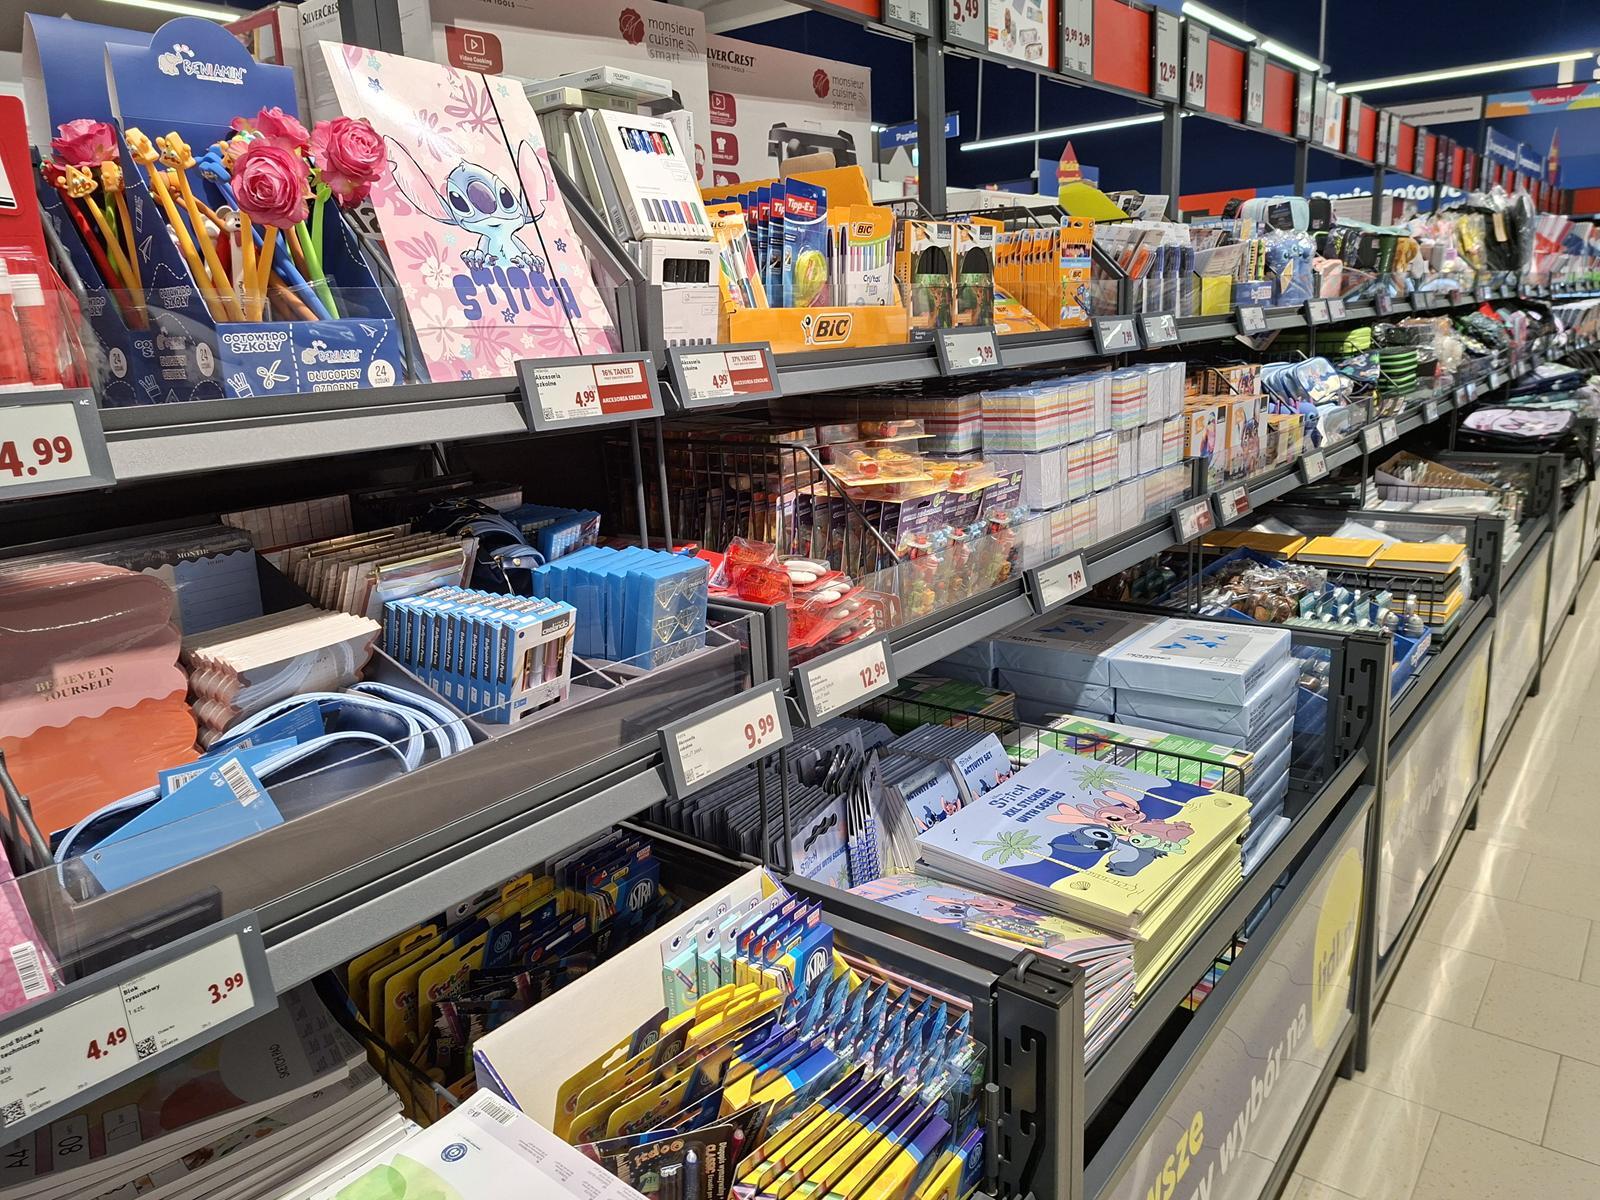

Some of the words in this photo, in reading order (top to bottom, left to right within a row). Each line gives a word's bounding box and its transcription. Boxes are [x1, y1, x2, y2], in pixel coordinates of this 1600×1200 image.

[302, 3, 339, 26] SILVERCRES
[953, 0, 979, 22] 5.49
[648, 18, 695, 37] monsieur
[648, 33, 684, 49] cuisine
[472, 57, 493, 66] Cooking
[649, 49, 681, 64] smart
[707, 47, 755, 67] LVERCREST
[832, 76, 864, 90] monsieur
[832, 87, 857, 99] cuisine
[832, 101, 854, 111] smart
[787, 198, 815, 213] Tipp-Ex
[453, 266, 582, 321] STITCH
[222, 333, 271, 344] GOTOWI
[271, 331, 288, 342] DO
[232, 341, 282, 353] SZKOŁY
[307, 368, 361, 382] DŁUGOPISY
[375, 365, 387, 377] 24
[535, 372, 561, 381] Akcesoria
[613, 366, 634, 376] TANIEJ
[536, 380, 557, 388] szkolne
[712, 374, 729, 389] 4.99
[575, 389, 597, 408] 4.99
[0, 435, 73, 478] 4.99
[1068, 570, 1082, 590] 7.99
[35, 670, 97, 693] BELIEVE
[102, 665, 114, 677] IN
[860, 661, 886, 689] 12.99
[44, 677, 114, 703] YOURSELF
[744, 714, 775, 749] 9.99
[964, 756, 985, 776] ACTIVITY
[983, 751, 993, 761] SET
[905, 782, 930, 801] ACTIVITY
[928, 776, 939, 787] SET
[1001, 806, 1023, 818] XXL
[1016, 787, 1050, 808] STICKER
[1015, 808, 1041, 823] WITH
[1035, 791, 1067, 811] SCENES
[123, 985, 139, 996] Blok
[125, 984, 161, 1003] rysunkowy
[207, 973, 244, 1004] 3.99
[15, 1033, 32, 1044] Blok
[33, 1027, 44, 1035] A4
[87, 1027, 127, 1060] 4.49
[0, 1038, 41, 1059] techniczny
[1220, 1041, 1284, 1175] wybór
[1286, 1003, 1307, 1062] na
[58, 1135, 83, 1156] 80
[5, 1148, 30, 1169] A4
